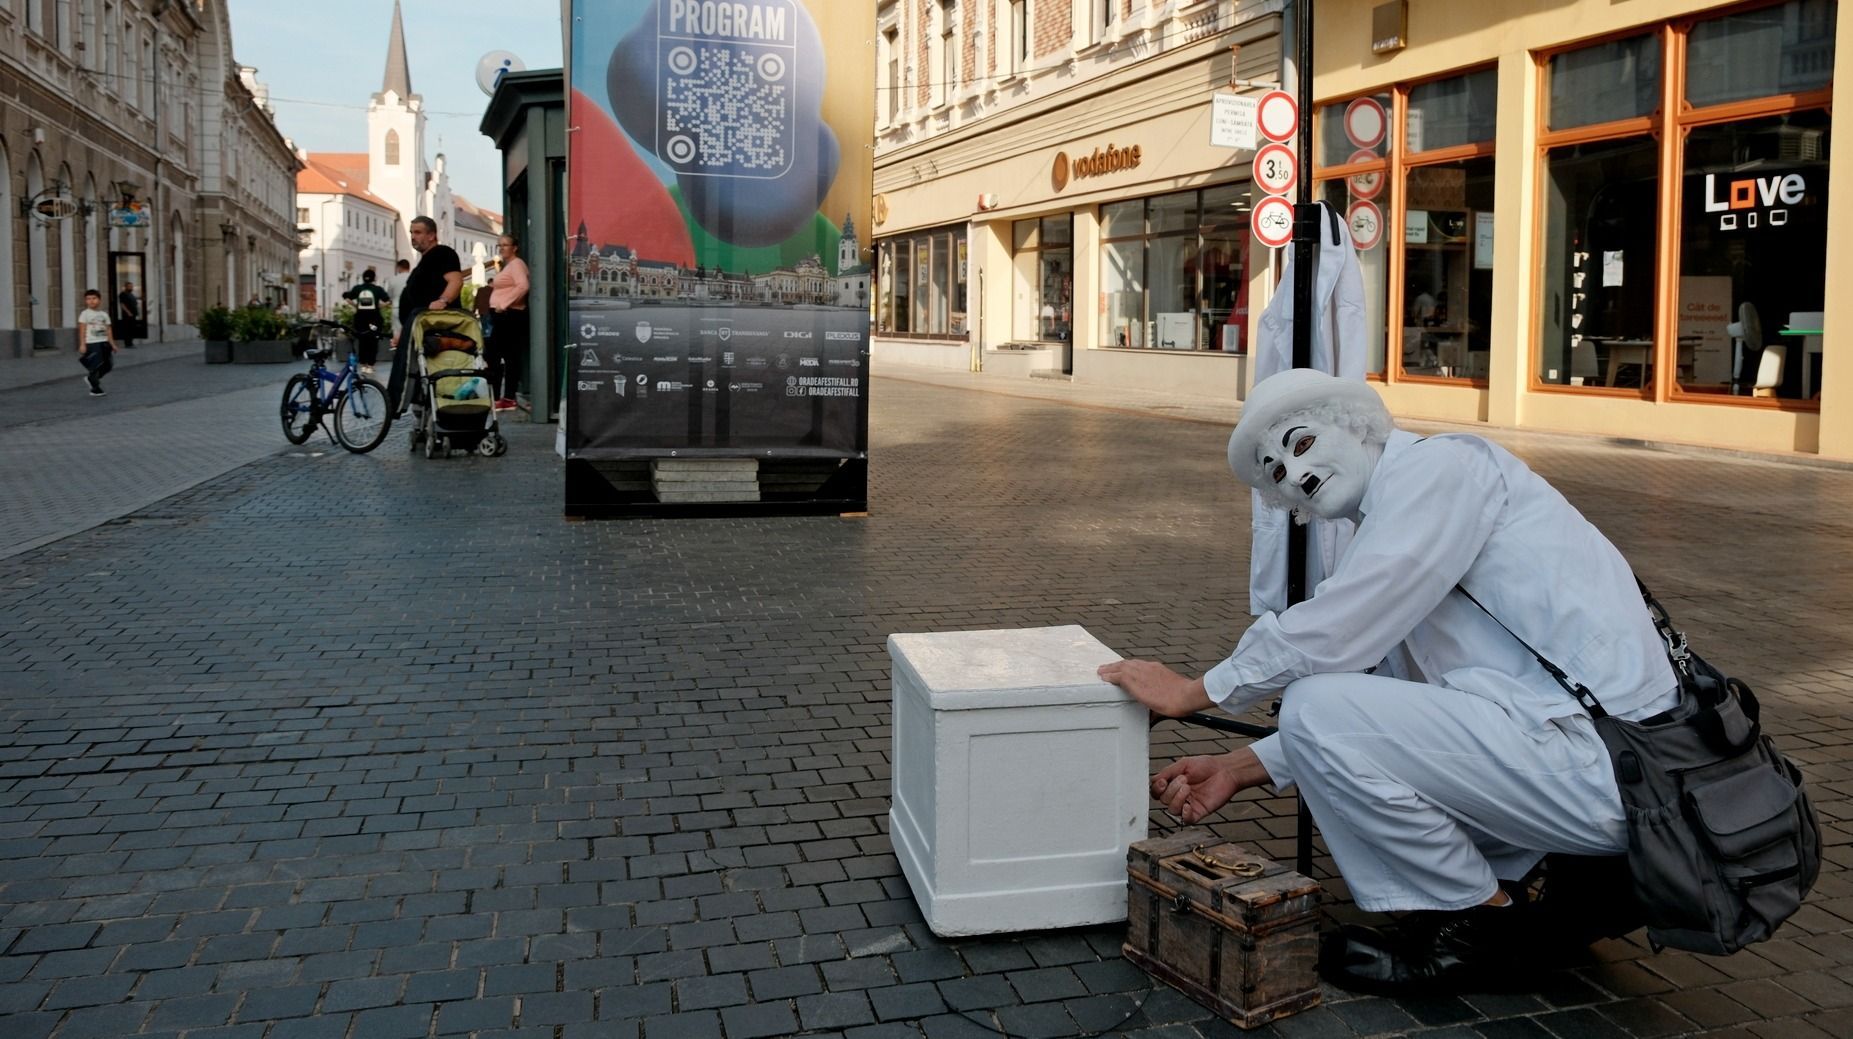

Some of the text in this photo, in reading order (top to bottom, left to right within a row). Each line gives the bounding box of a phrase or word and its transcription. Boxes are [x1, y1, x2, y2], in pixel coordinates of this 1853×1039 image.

[669, 0, 785, 41] PROGRAM
[1072, 143, 1141, 181] vodafone
[1705, 173, 1806, 213] Love
[783, 331, 813, 339] DIGI
[798, 376, 859, 387] ORADEAFESTIFALL.RO
[808, 386, 860, 397] ORADEAFESTIFALL
